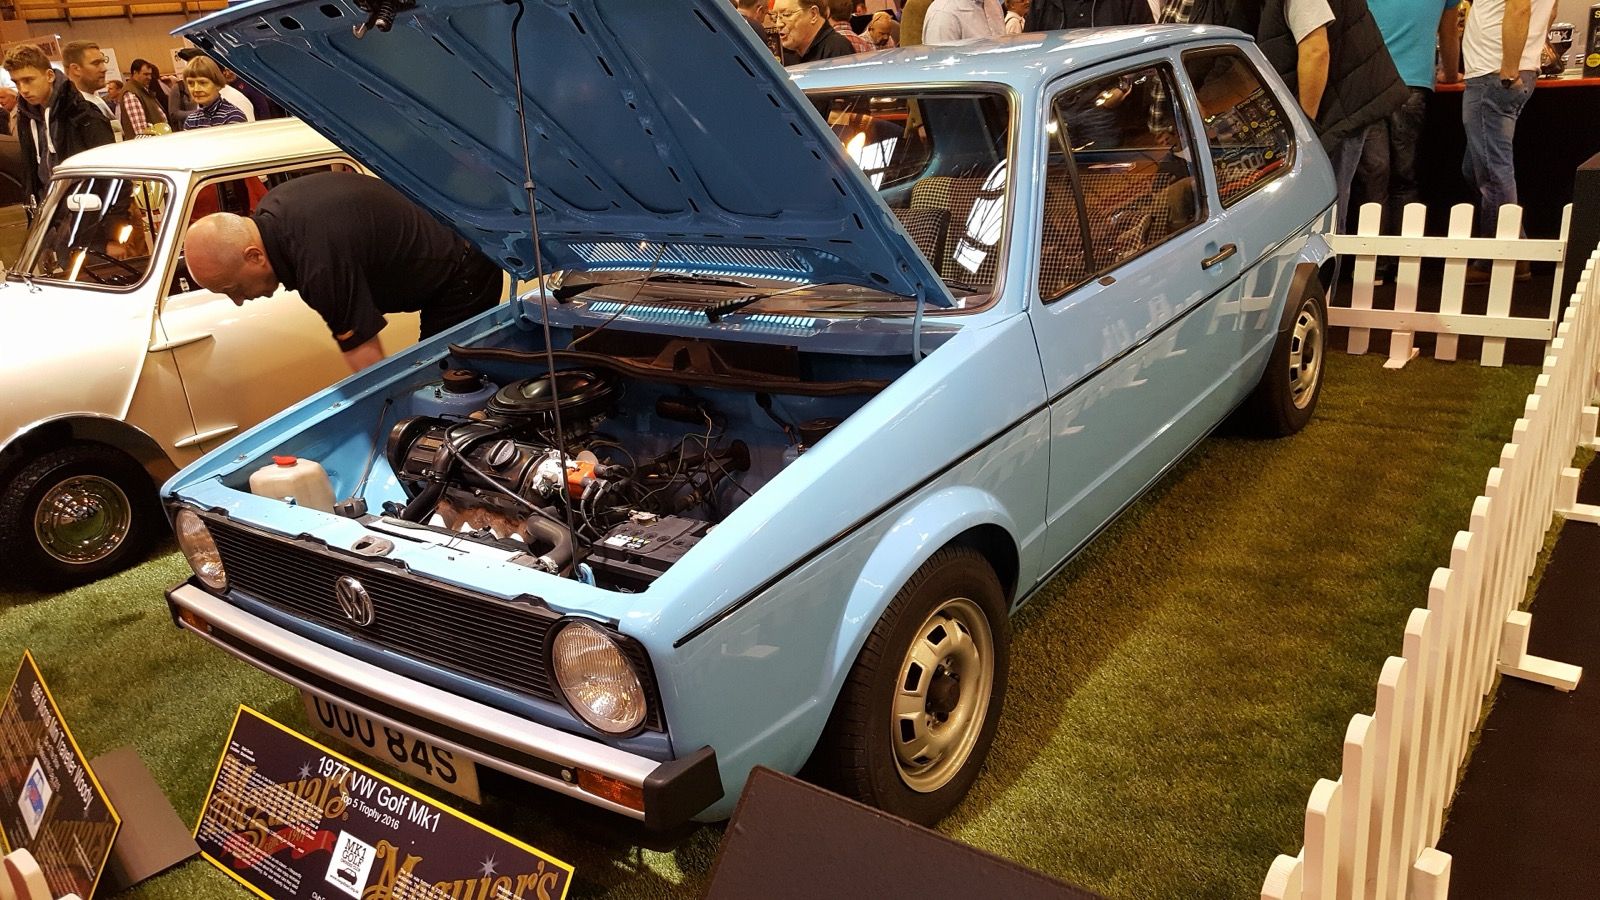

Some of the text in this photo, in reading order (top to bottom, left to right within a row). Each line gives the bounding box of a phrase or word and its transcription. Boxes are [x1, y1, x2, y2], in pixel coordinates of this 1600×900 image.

[383, 726, 458, 784] 84S
[73, 764, 94, 811] Woody
[318, 755, 441, 833] 1977 VW Golf Mk1
[340, 791, 400, 830] Top 5 Trophy 2016
[342, 849, 364, 867] GOLF
[344, 838, 367, 860] MK1
